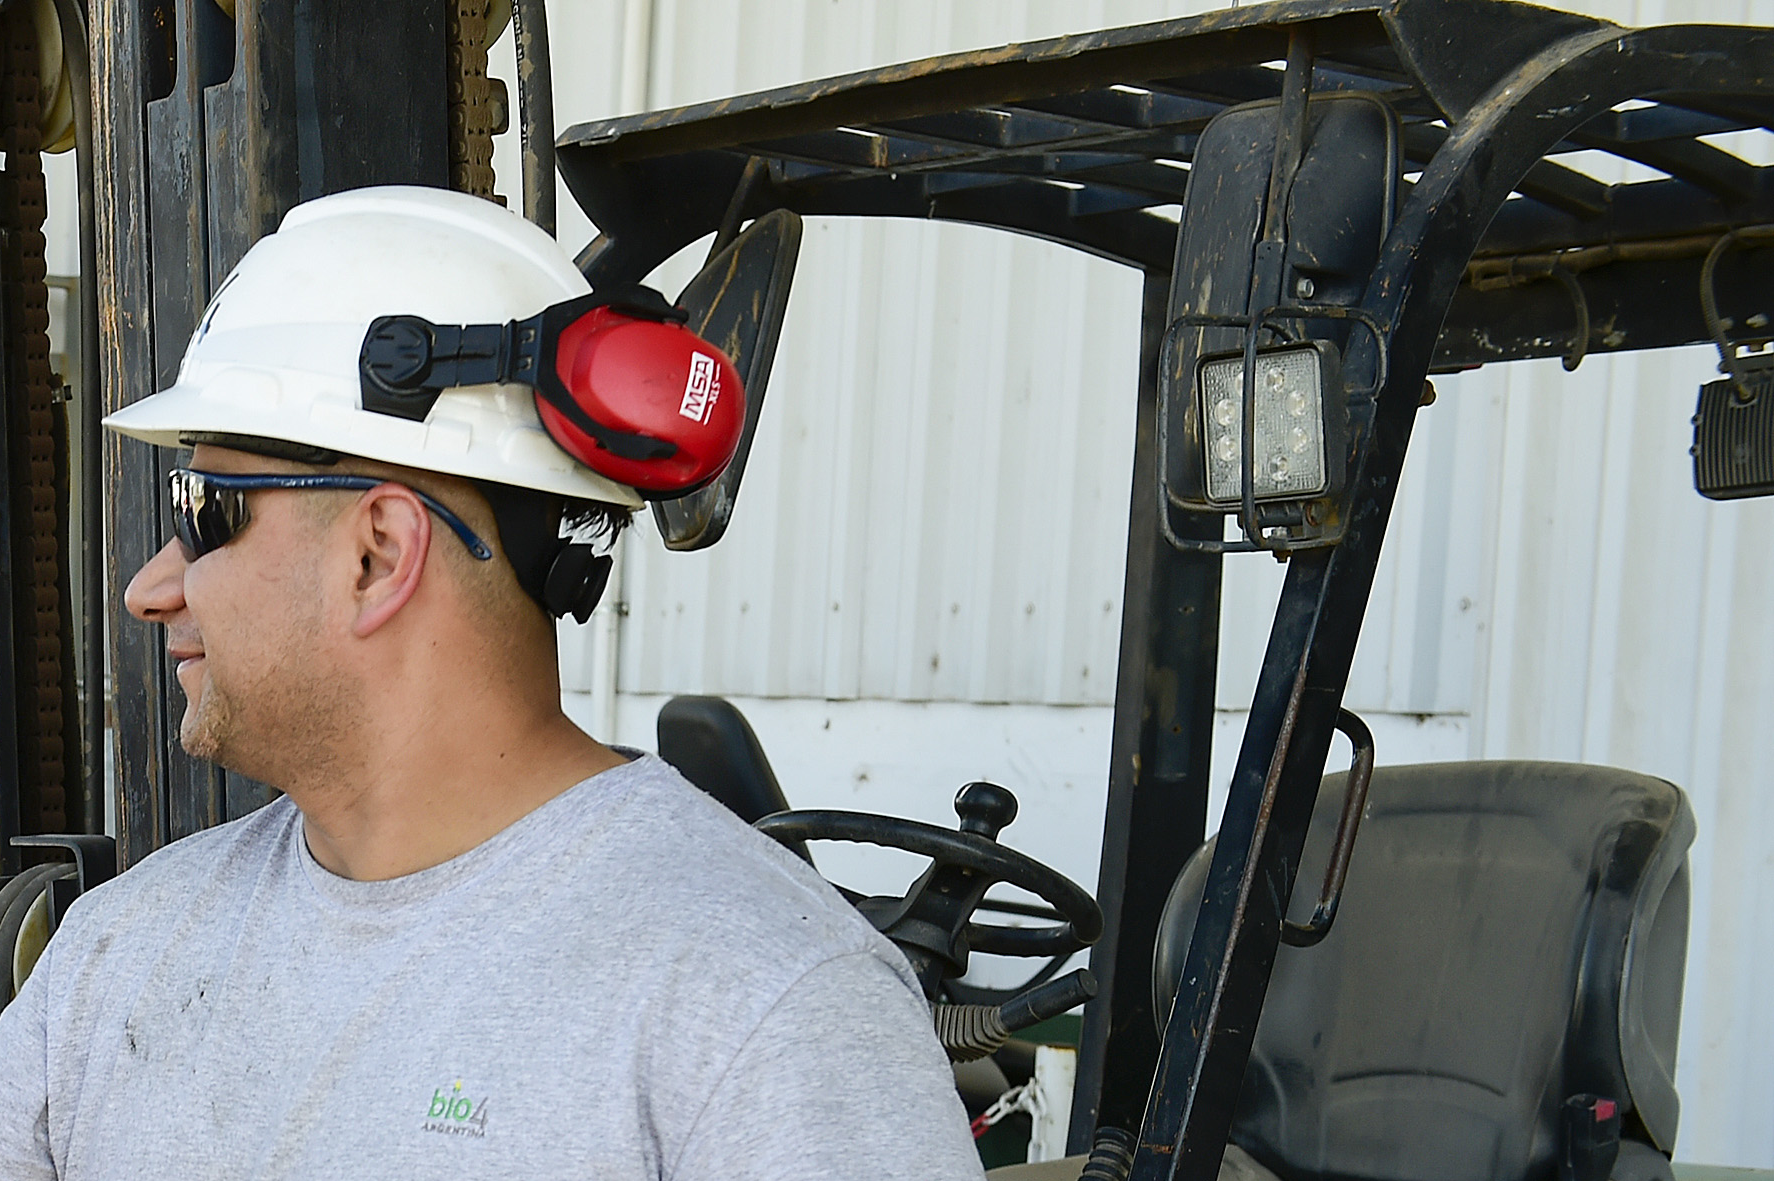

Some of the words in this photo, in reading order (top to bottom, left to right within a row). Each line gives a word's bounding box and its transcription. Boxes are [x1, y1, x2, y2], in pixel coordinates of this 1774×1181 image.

[685, 359, 711, 416] MSA
[427, 1079, 489, 1129] bio4
[421, 1121, 486, 1139] ARGENTINA
